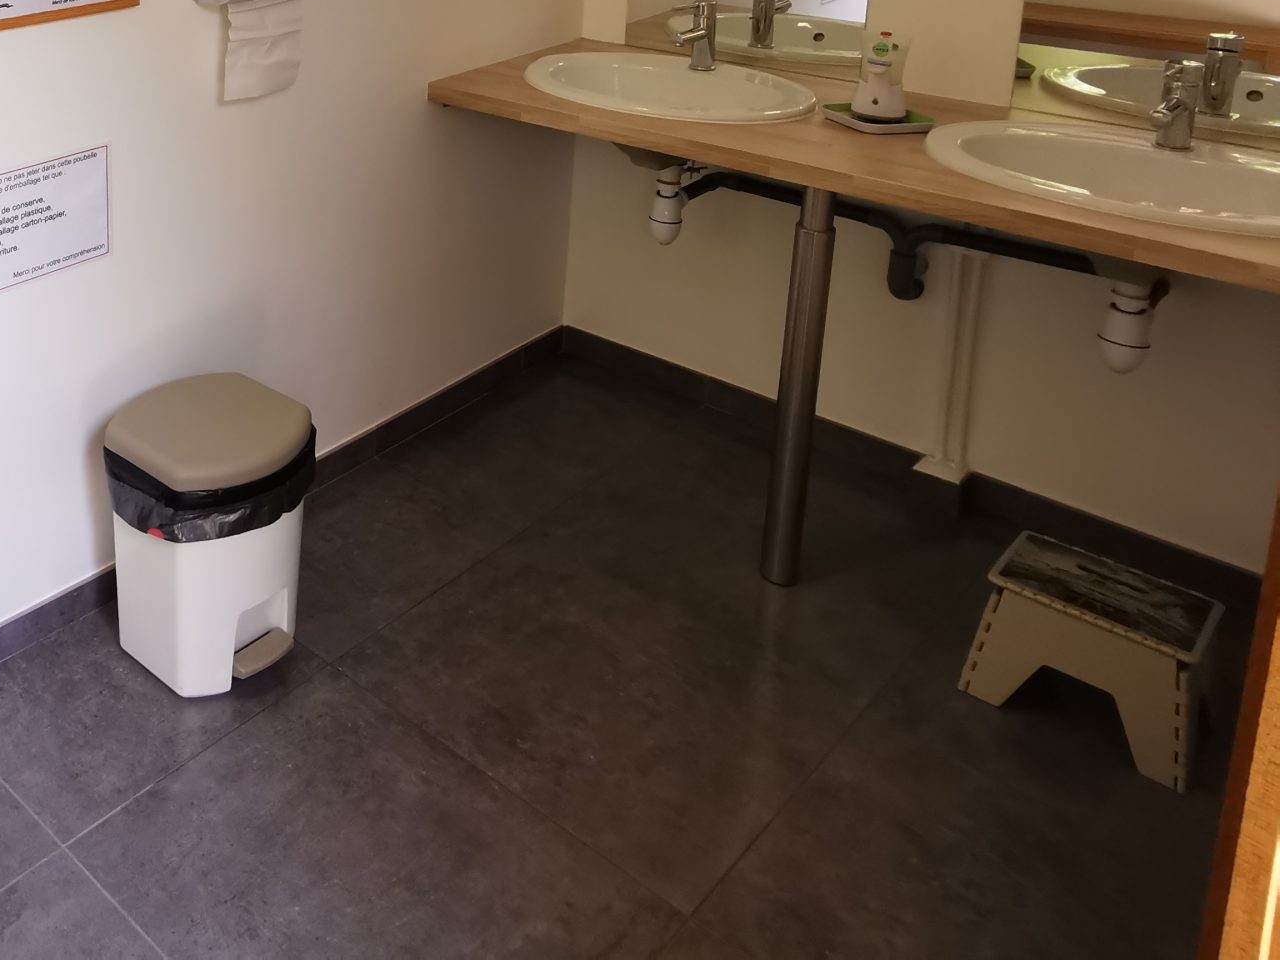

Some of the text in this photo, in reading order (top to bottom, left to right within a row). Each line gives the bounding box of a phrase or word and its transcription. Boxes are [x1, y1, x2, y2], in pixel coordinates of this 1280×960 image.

[14, 173, 25, 184] pas
[26, 168, 40, 180] jeter
[42, 164, 56, 173] dans
[58, 159, 72, 168] cette
[72, 152, 98, 164] poubelle
[4, 178, 41, 192] d'emballage
[52, 171, 62, 180] que
[1, 206, 10, 214] de
[12, 197, 46, 210] conserve,
[13, 243, 106, 278] Merci pour votre compréhension
